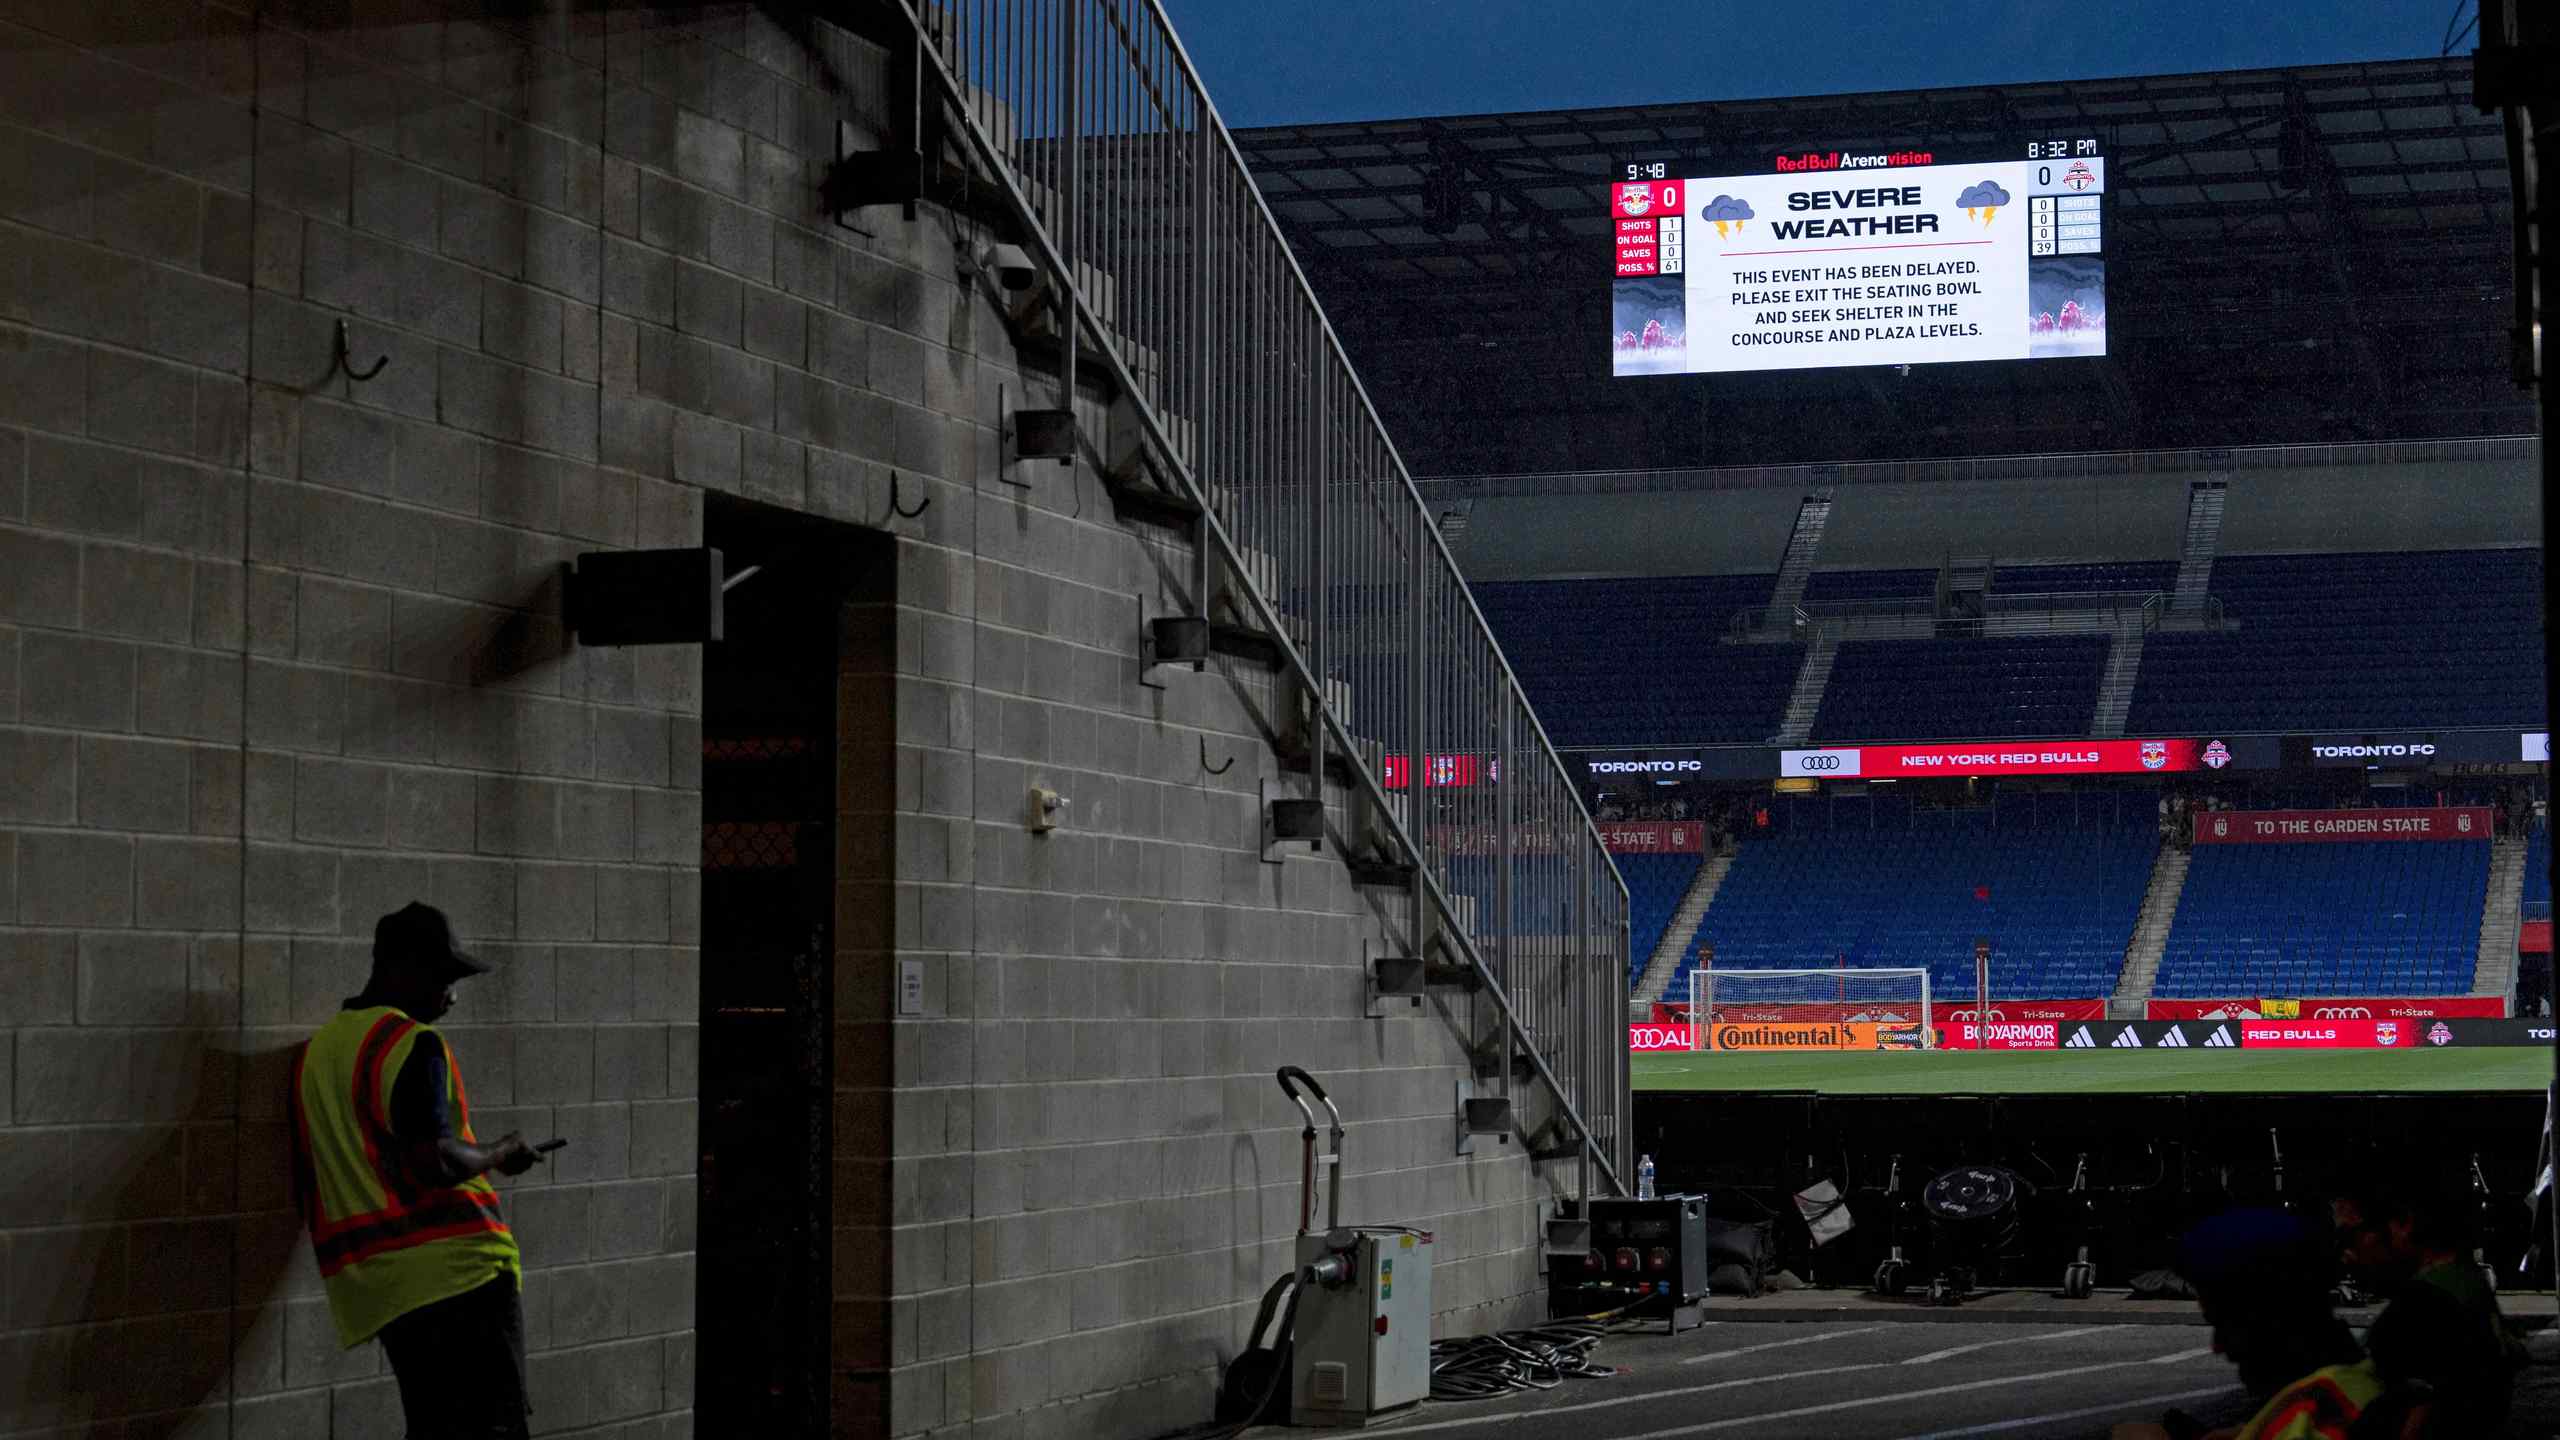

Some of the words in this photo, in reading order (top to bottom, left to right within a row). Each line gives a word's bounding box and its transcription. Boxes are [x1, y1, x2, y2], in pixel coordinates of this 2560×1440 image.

[2028, 141, 2067, 158] 8:32
[2077, 139, 2097, 155] PM
[1627, 163, 1665, 180] 9:48
[2038, 166, 2051, 186] 0
[1663, 187, 1676, 208] 0
[1788, 186, 1921, 211] SEVERE
[2040, 199, 2048, 210] 0
[1669, 219, 1675, 229] 1
[2040, 213, 2048, 225] 0
[1621, 221, 1652, 231] SHOTS
[1771, 213, 1939, 240] WEATHER
[1617, 236, 1630, 245] ON
[1632, 234, 1656, 243] GOAL
[1668, 232, 1675, 243] 0
[2040, 228, 2048, 239] 0
[1621, 248, 1651, 258] SAVES
[1668, 247, 1675, 257] 0
[2037, 242, 2052, 253] 39
[1618, 263, 1645, 272] POSS.
[1665, 260, 1678, 271] 61
[1732, 271, 1767, 284] THIS
[1772, 268, 1821, 283] EVENT
[1825, 266, 1857, 280] HAS
[1861, 264, 1901, 279] BEEN
[1906, 261, 1980, 277] DELAYED.
[1732, 290, 1791, 305] PLEASE
[1795, 288, 1828, 302] EXIT
[1832, 287, 1862, 300] THE
[1867, 284, 1931, 299] SEATING
[1936, 281, 1982, 296] BOWL
[1755, 311, 1787, 325] AND
[1791, 309, 1831, 323] SEEK
[1836, 306, 1903, 321] SHELTER
[1908, 305, 1923, 318] IN
[1928, 303, 1958, 317] THE
[1731, 330, 1824, 346] CONCOURSE
[1828, 328, 1860, 342] AND
[1865, 326, 1915, 340] PLAZA
[1920, 323, 1983, 338] LEVELS.
[2312, 745, 2406, 758] TORONTO
[2409, 744, 2436, 756] FC
[1901, 755, 1943, 766] NEW
[1947, 754, 1996, 765] YORK
[2000, 753, 2037, 764] RED
[2040, 752, 2099, 763] BULLS
[1588, 761, 1675, 773] TORONTO
[1678, 760, 1702, 771] FC
[2254, 821, 2275, 834] TO
[2278, 820, 2309, 833] THE
[2314, 819, 2378, 833] GARDEN
[2382, 818, 2431, 832] STATE
[1611, 832, 1656, 845] STATE
[1742, 1013, 1784, 1022] Tri-State
[2023, 1010, 2065, 1019] Tri-State
[2390, 1008, 2434, 1017] Tri-State
[1718, 1025, 1839, 1050] Continental
[2248, 1030, 2281, 1040] RED
[2284, 1030, 2336, 1040] BULLS
[2008, 1040, 2033, 1048] Sports
[2035, 1039, 2055, 1047] Drink
